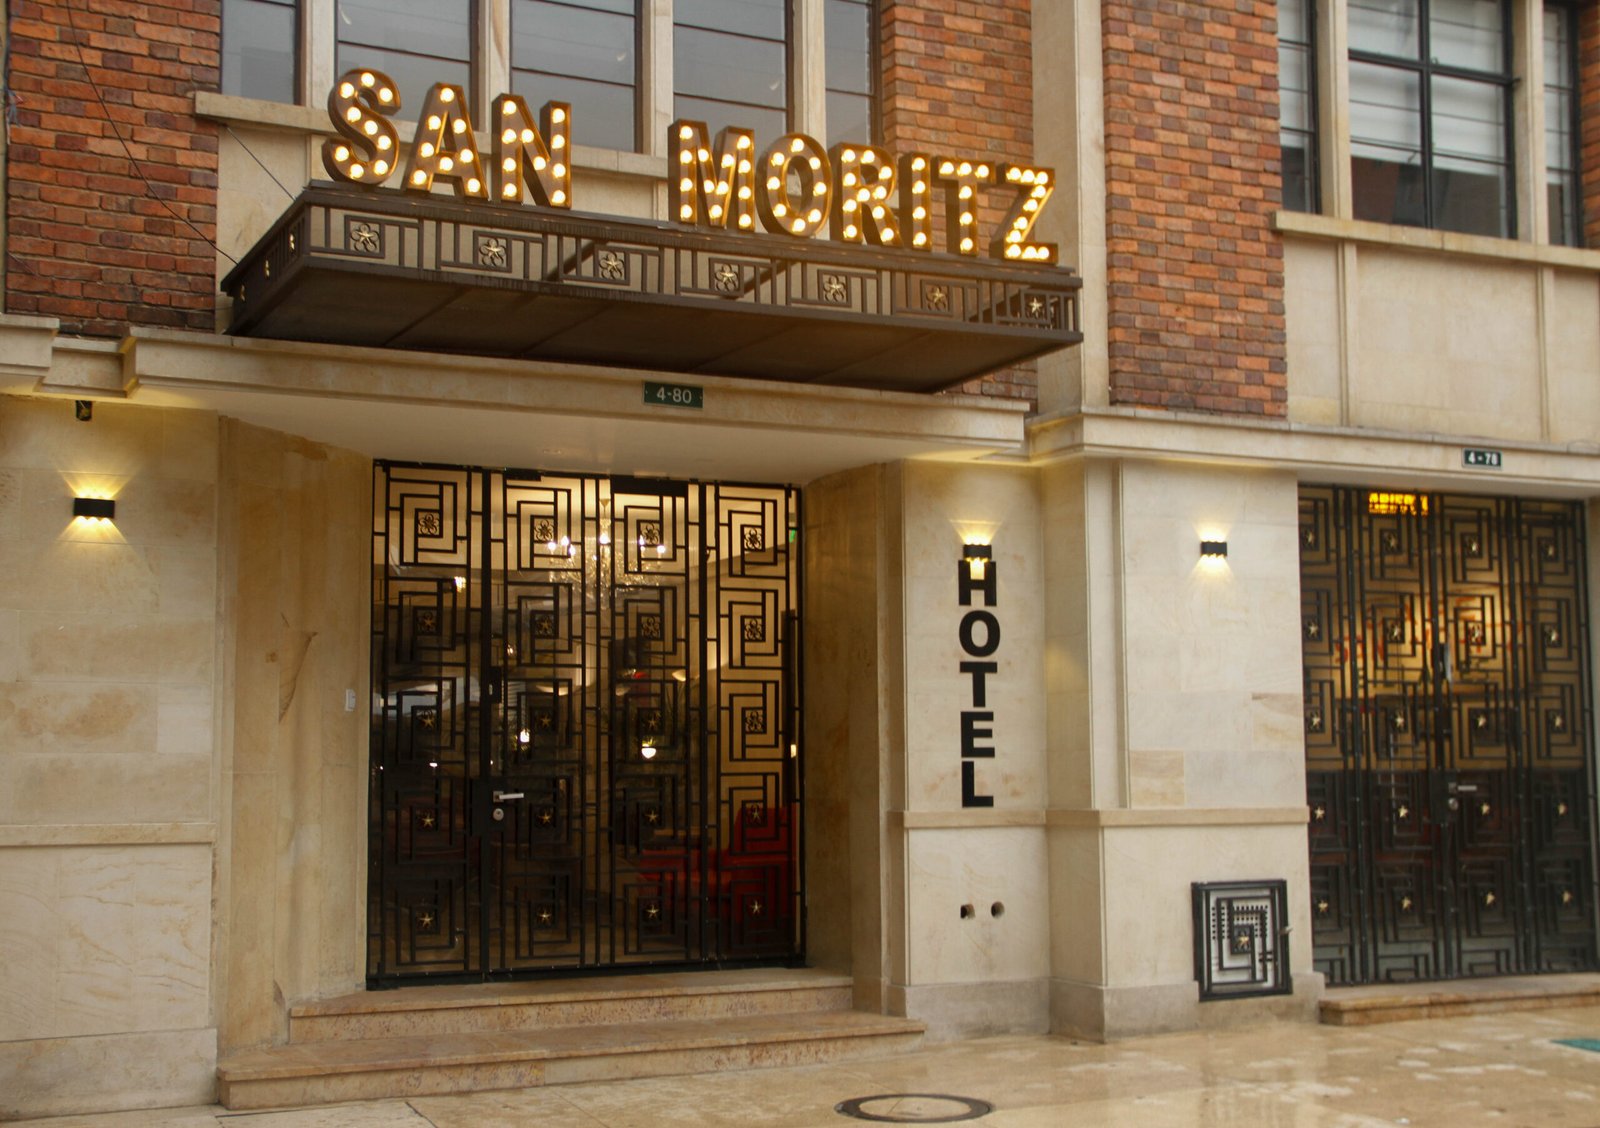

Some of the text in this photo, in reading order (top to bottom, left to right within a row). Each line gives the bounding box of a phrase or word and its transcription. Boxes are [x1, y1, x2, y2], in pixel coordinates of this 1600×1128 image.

[321, 67, 1059, 266] SAN MORITZ
[656, 386, 693, 404] 4-80
[958, 559, 1001, 808] HOTEL
